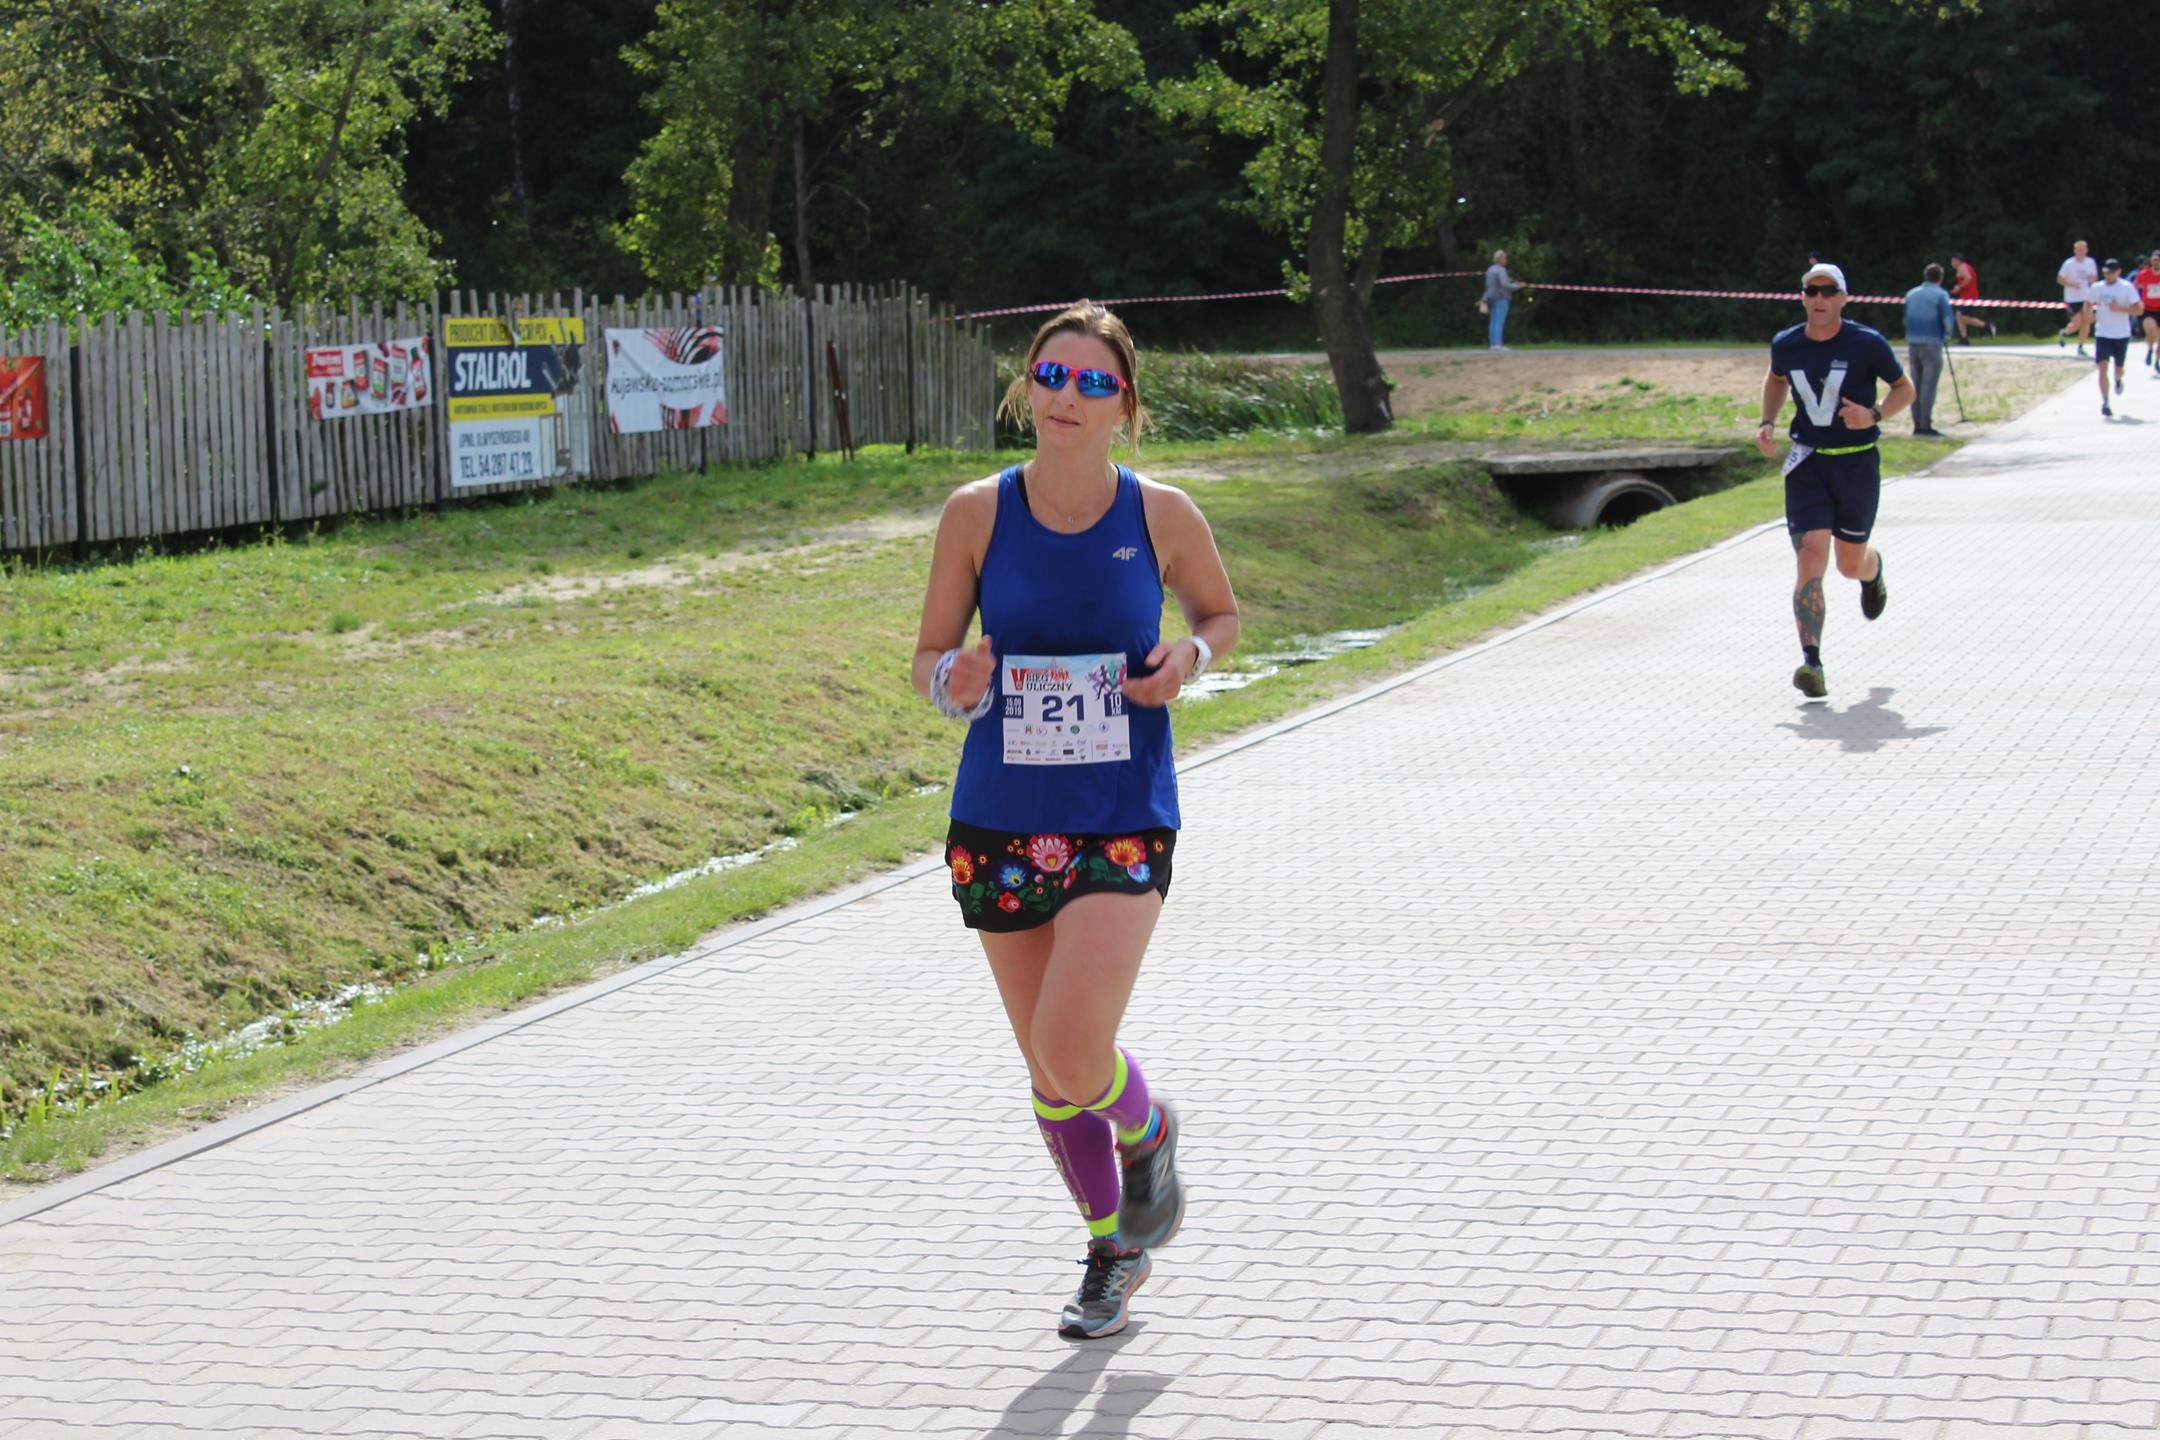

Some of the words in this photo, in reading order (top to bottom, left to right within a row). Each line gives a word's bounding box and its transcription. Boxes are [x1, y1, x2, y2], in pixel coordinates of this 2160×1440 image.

[454, 351, 531, 391] STALROL
[1790, 369, 1847, 426] V
[1112, 546, 1138, 561] 4F
[1026, 682, 1072, 691] ULICZNY
[1005, 705, 1022, 716] 2019
[1042, 694, 1085, 722] 21
